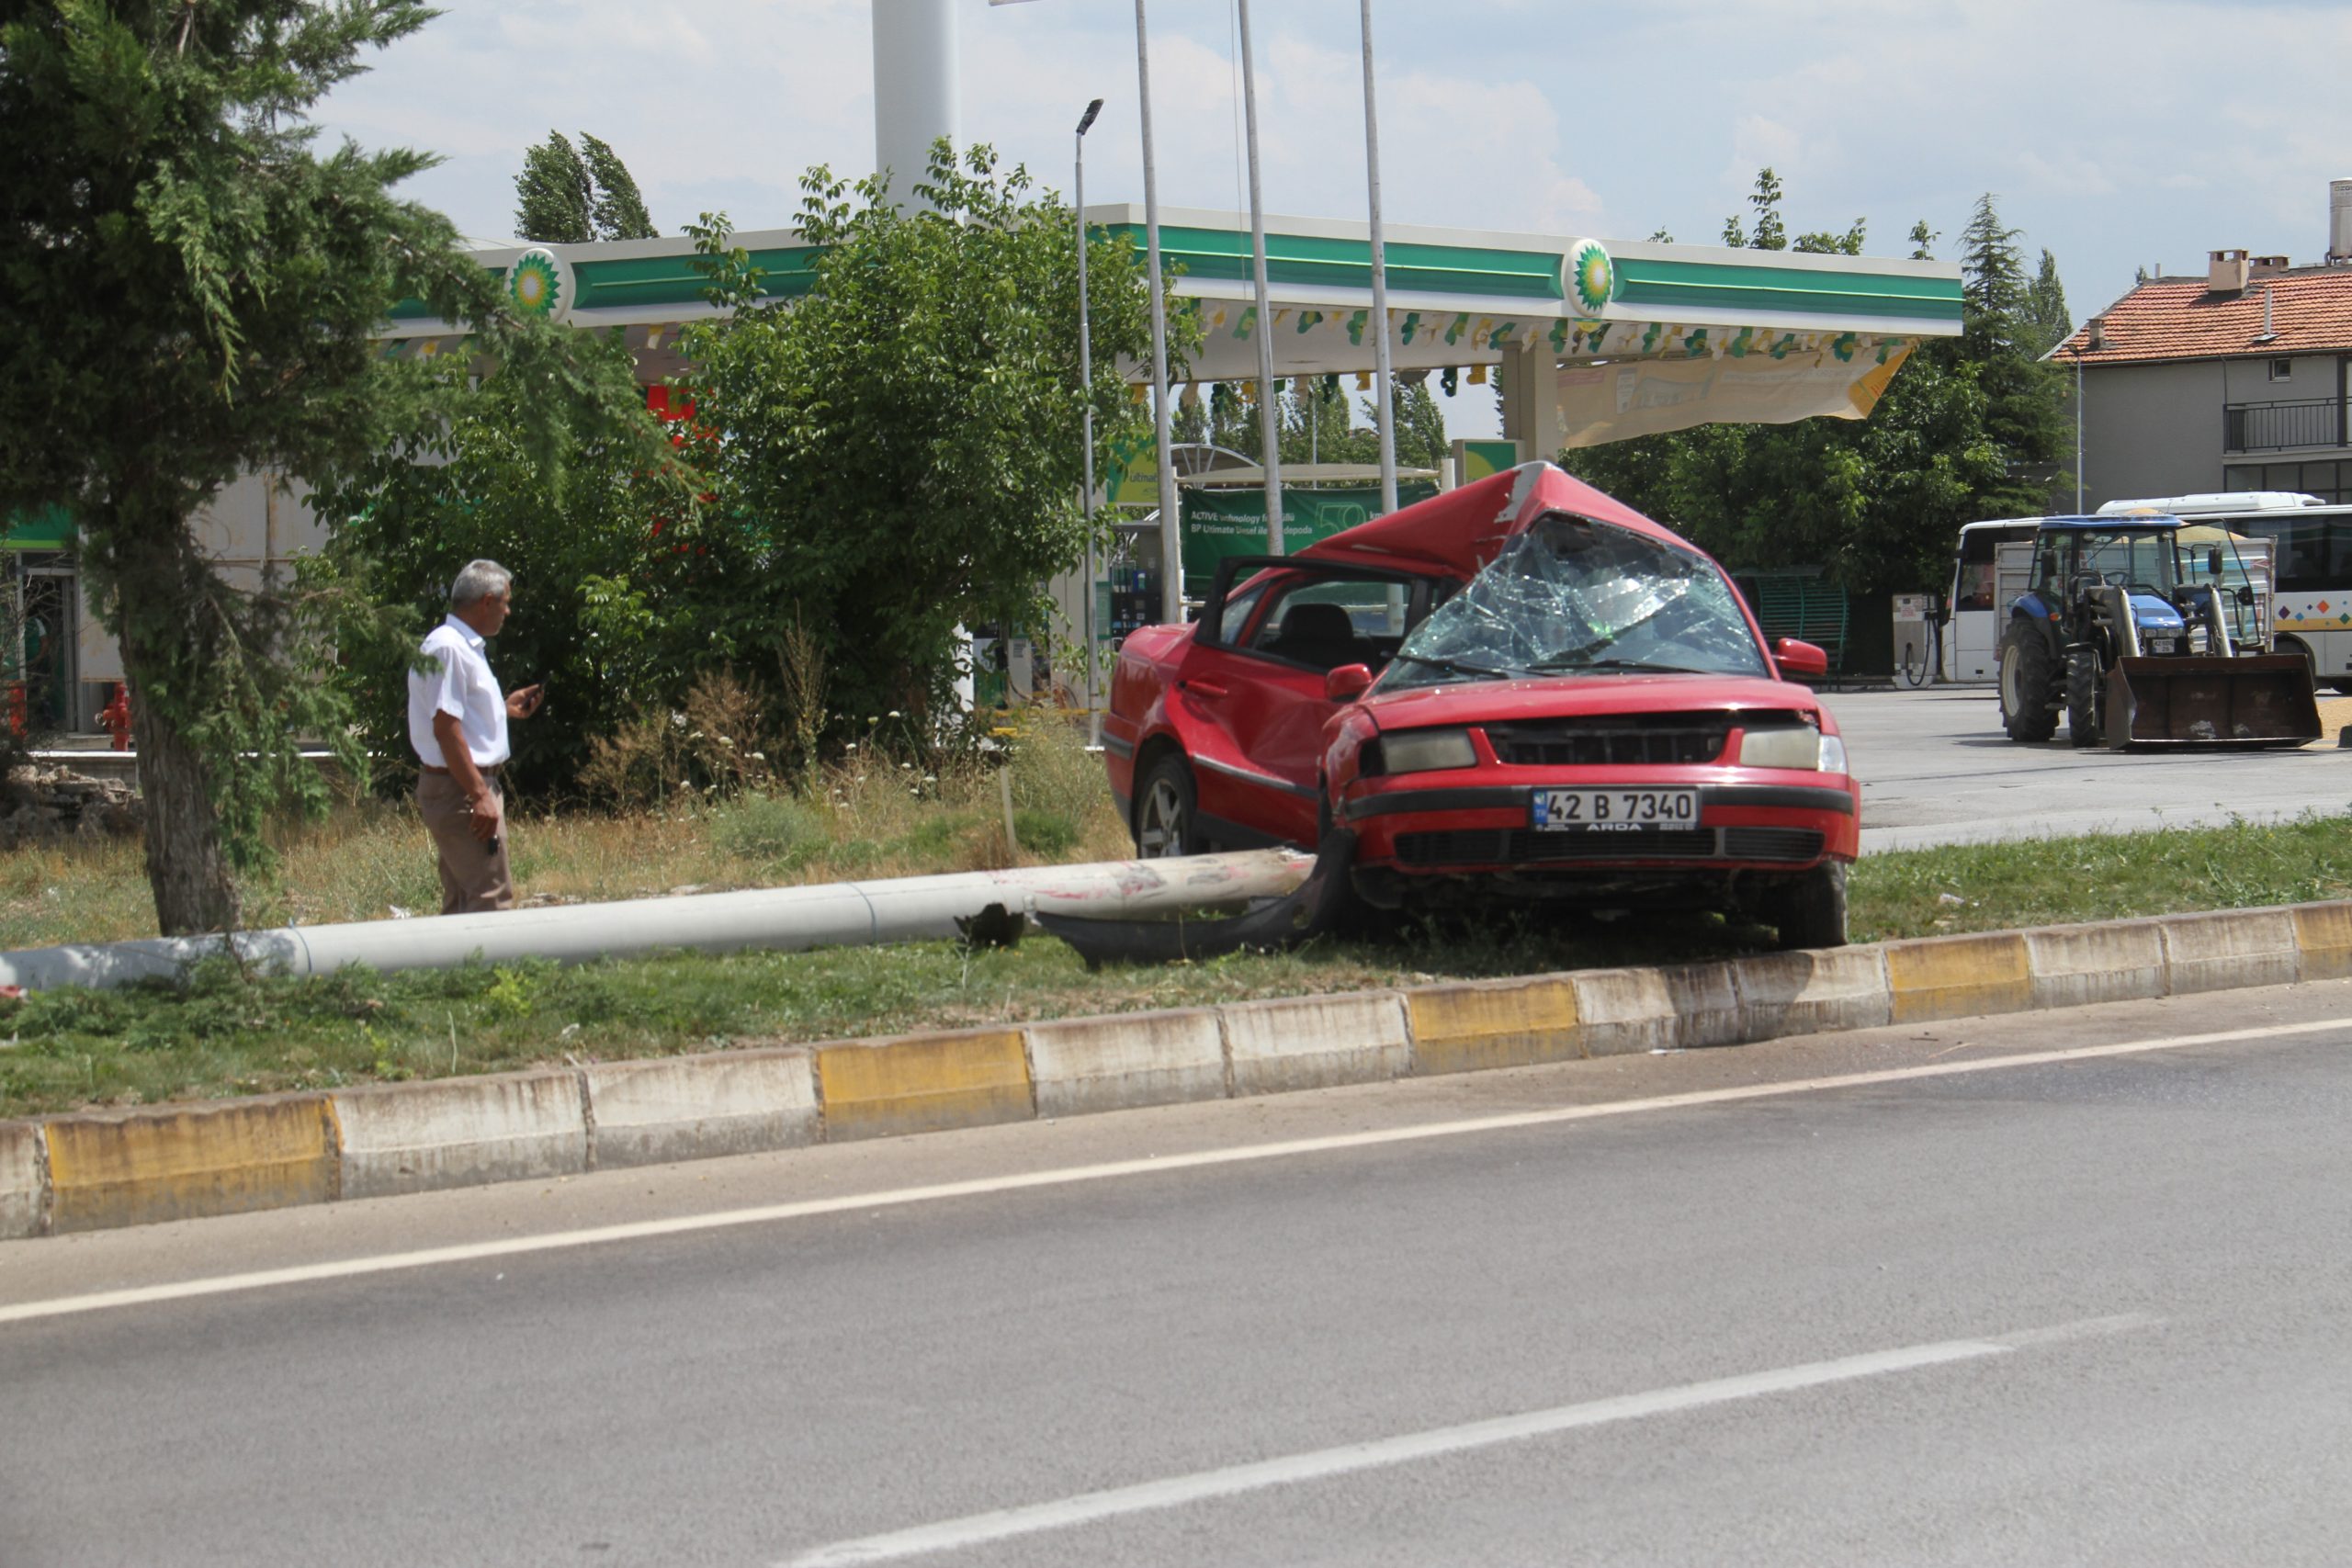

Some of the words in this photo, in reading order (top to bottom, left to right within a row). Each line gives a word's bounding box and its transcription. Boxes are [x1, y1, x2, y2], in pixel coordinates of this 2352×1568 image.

[1191, 511, 1218, 521] ACTIVE
[1191, 524, 1202, 533] BP
[1548, 794, 1580, 819] 42
[1594, 794, 1610, 819] B
[1623, 794, 1691, 819] 7340
